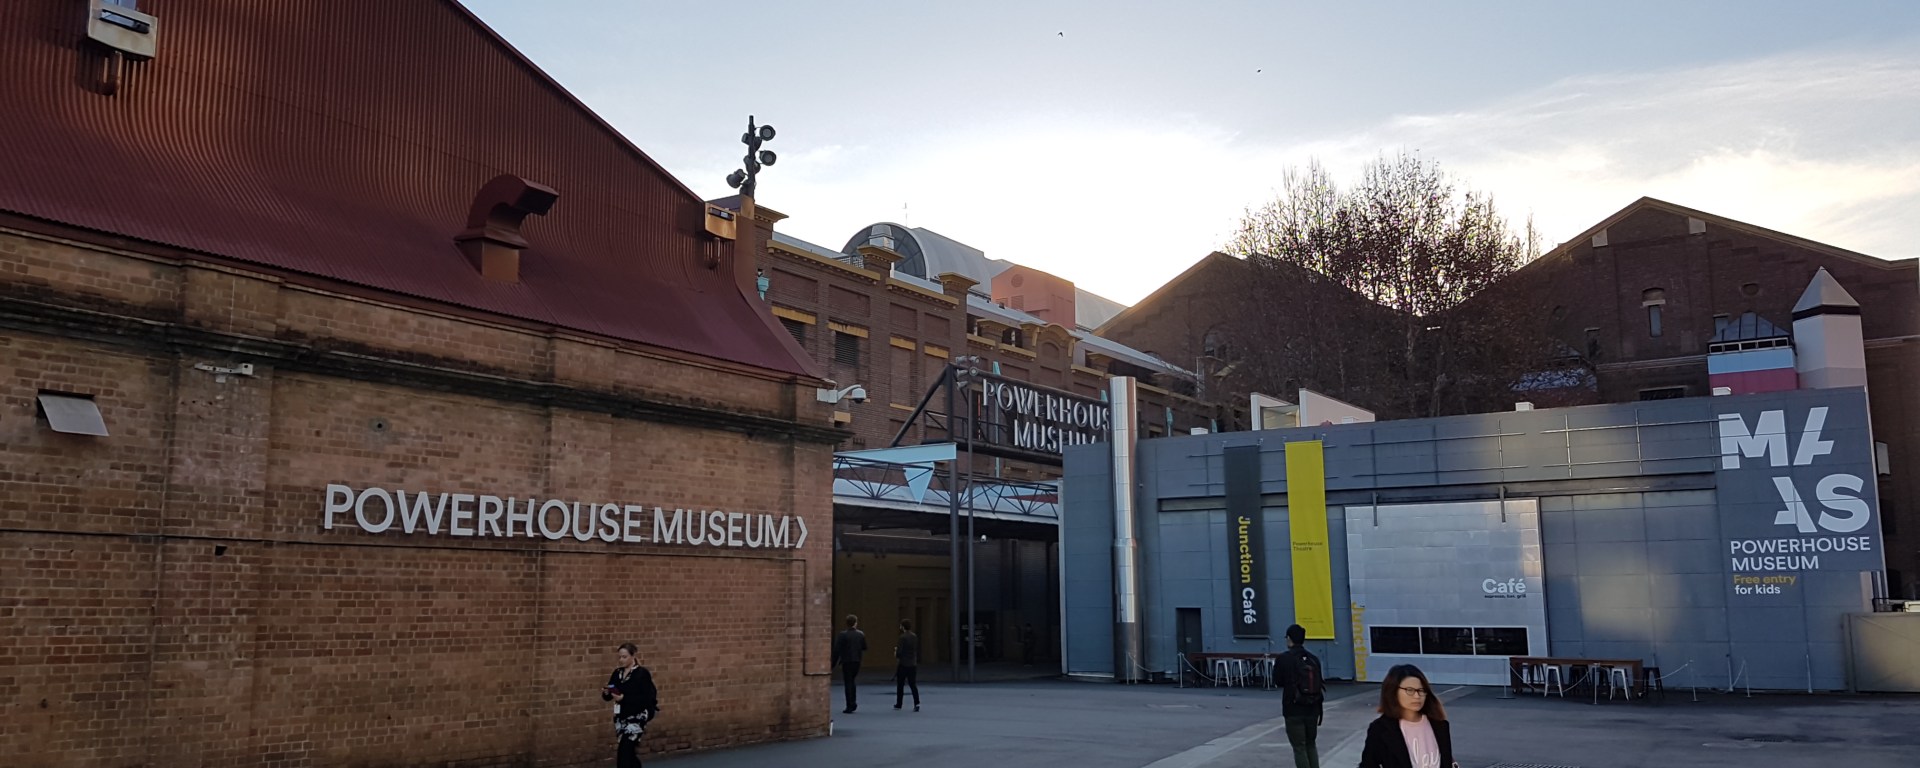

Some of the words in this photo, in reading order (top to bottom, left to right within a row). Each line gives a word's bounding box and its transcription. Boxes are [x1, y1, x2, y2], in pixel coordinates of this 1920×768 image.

[983, 378, 1110, 432] POWERHOUS
[323, 483, 643, 544] POWERHOUSE
[652, 506, 791, 549] MUSEUM
[1237, 515, 1254, 583] Junction
[1730, 536, 1871, 555] POWERHOUSE
[1732, 555, 1819, 571] MUSEUM
[1482, 578, 1526, 593] Café
[1733, 574, 1760, 584] Free
[1762, 575, 1797, 587] entry
[1735, 584, 1752, 595] for
[1755, 584, 1781, 595] kids
[1242, 587, 1257, 624] Café
[1351, 601, 1368, 680] Junction
